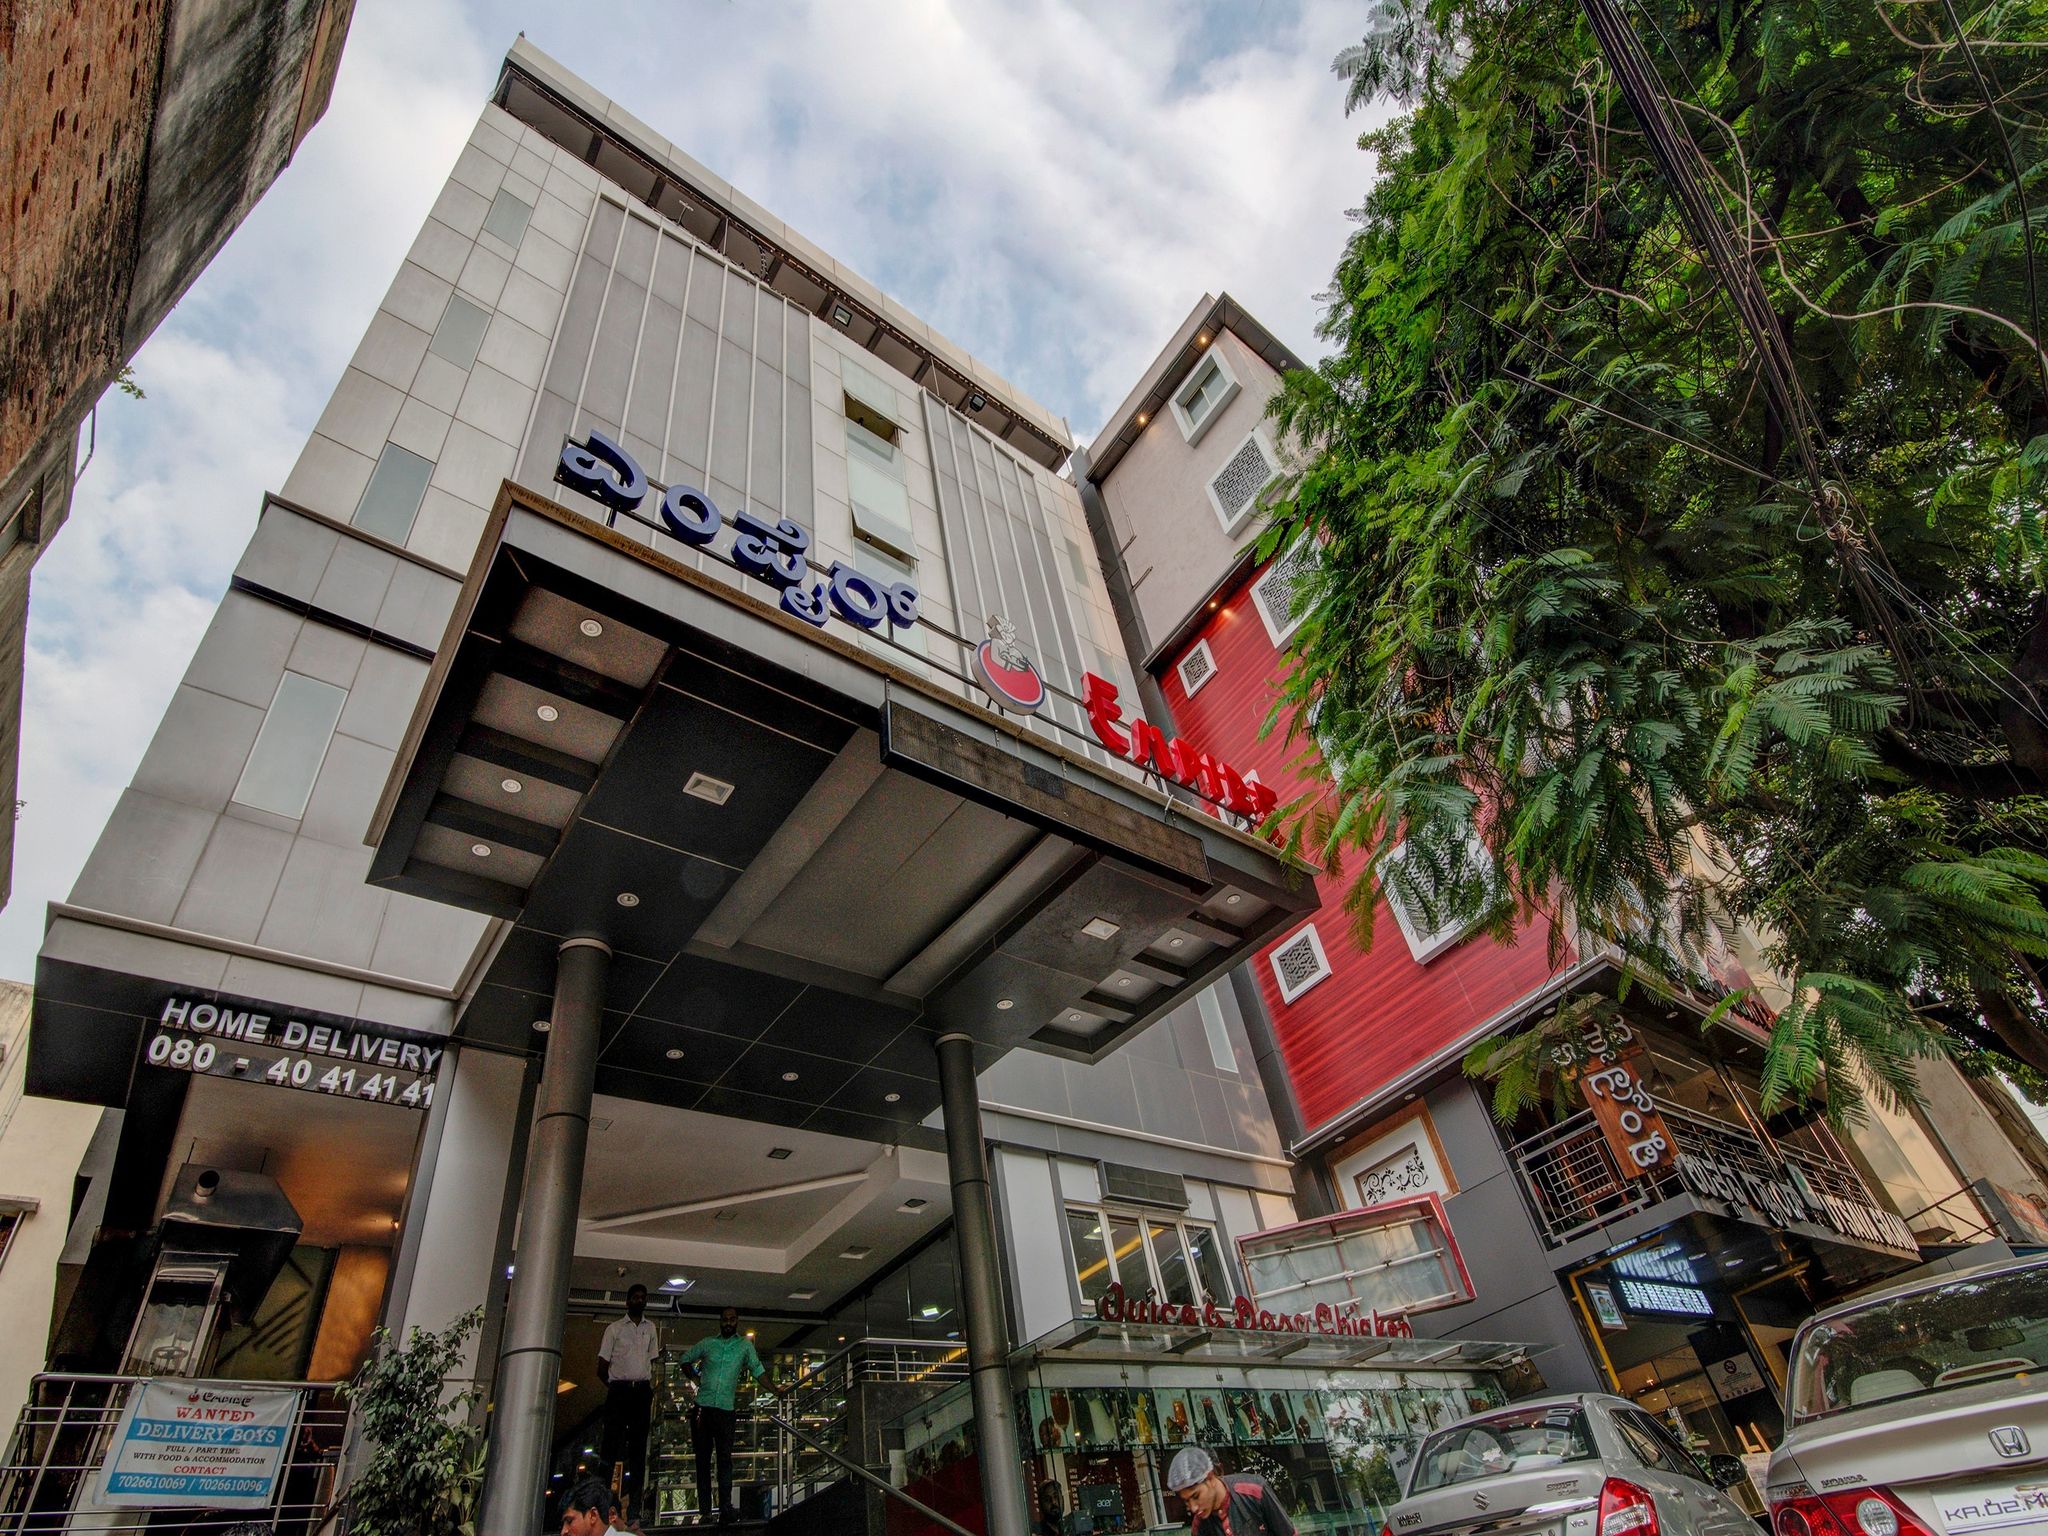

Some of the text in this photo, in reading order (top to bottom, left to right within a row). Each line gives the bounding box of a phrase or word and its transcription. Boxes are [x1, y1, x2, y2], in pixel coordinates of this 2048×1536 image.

[558, 430, 919, 629] ಎಂಪೈರ್
[161, 998, 443, 1074] HOME DELIVERY
[147, 1034, 217, 1073] 080
[1818, 1193, 1920, 1252] UTSAVA GRAND
[176, 1406, 255, 1422] WANTED
[137, 1422, 277, 1444] DELIVERY BOYS
[133, 1452, 156, 1460] WITH
[158, 1453, 182, 1461] FOOD
[193, 1455, 265, 1465] ACCOMMODATION
[173, 1465, 228, 1474] CONTACT
[118, 1475, 186, 1489] 7026610069
[199, 1478, 263, 1492] 7026610096
